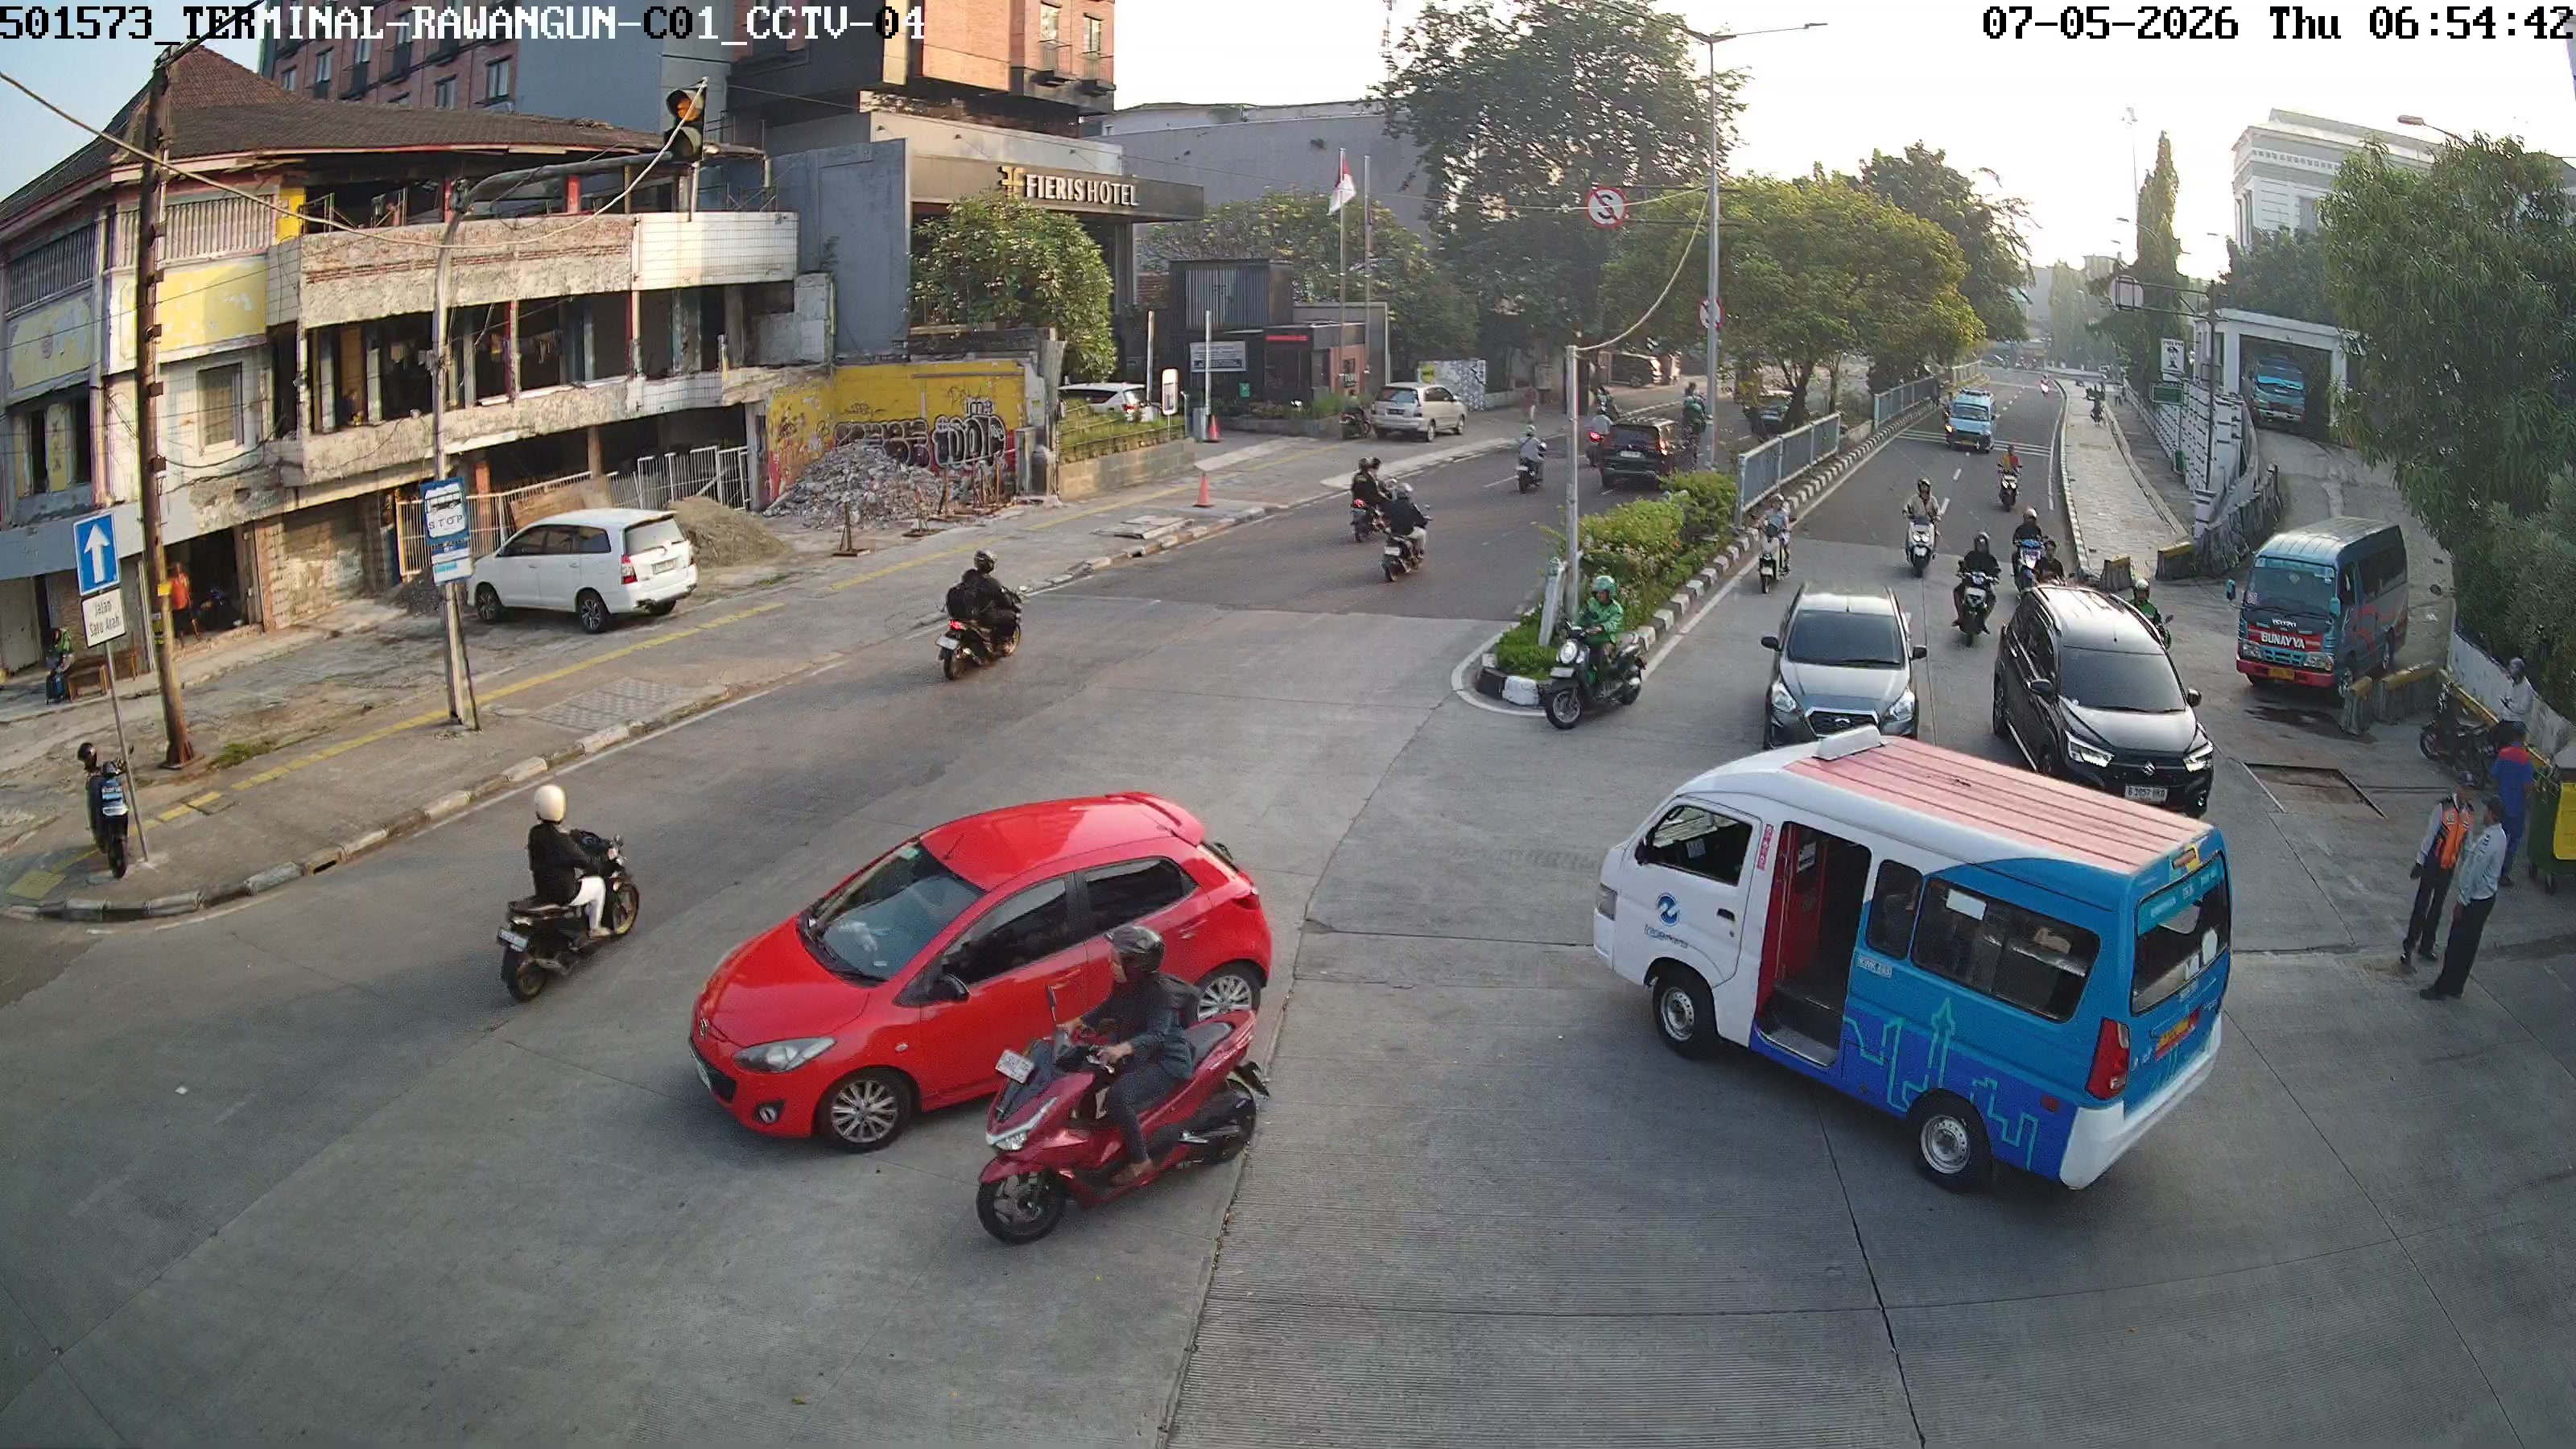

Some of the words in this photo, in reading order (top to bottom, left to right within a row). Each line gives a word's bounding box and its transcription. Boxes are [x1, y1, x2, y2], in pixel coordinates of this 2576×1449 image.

[1025, 173, 1086, 202] FIERIS
[1087, 180, 1140, 206] HOTEL
[428, 514, 463, 530] STOP
